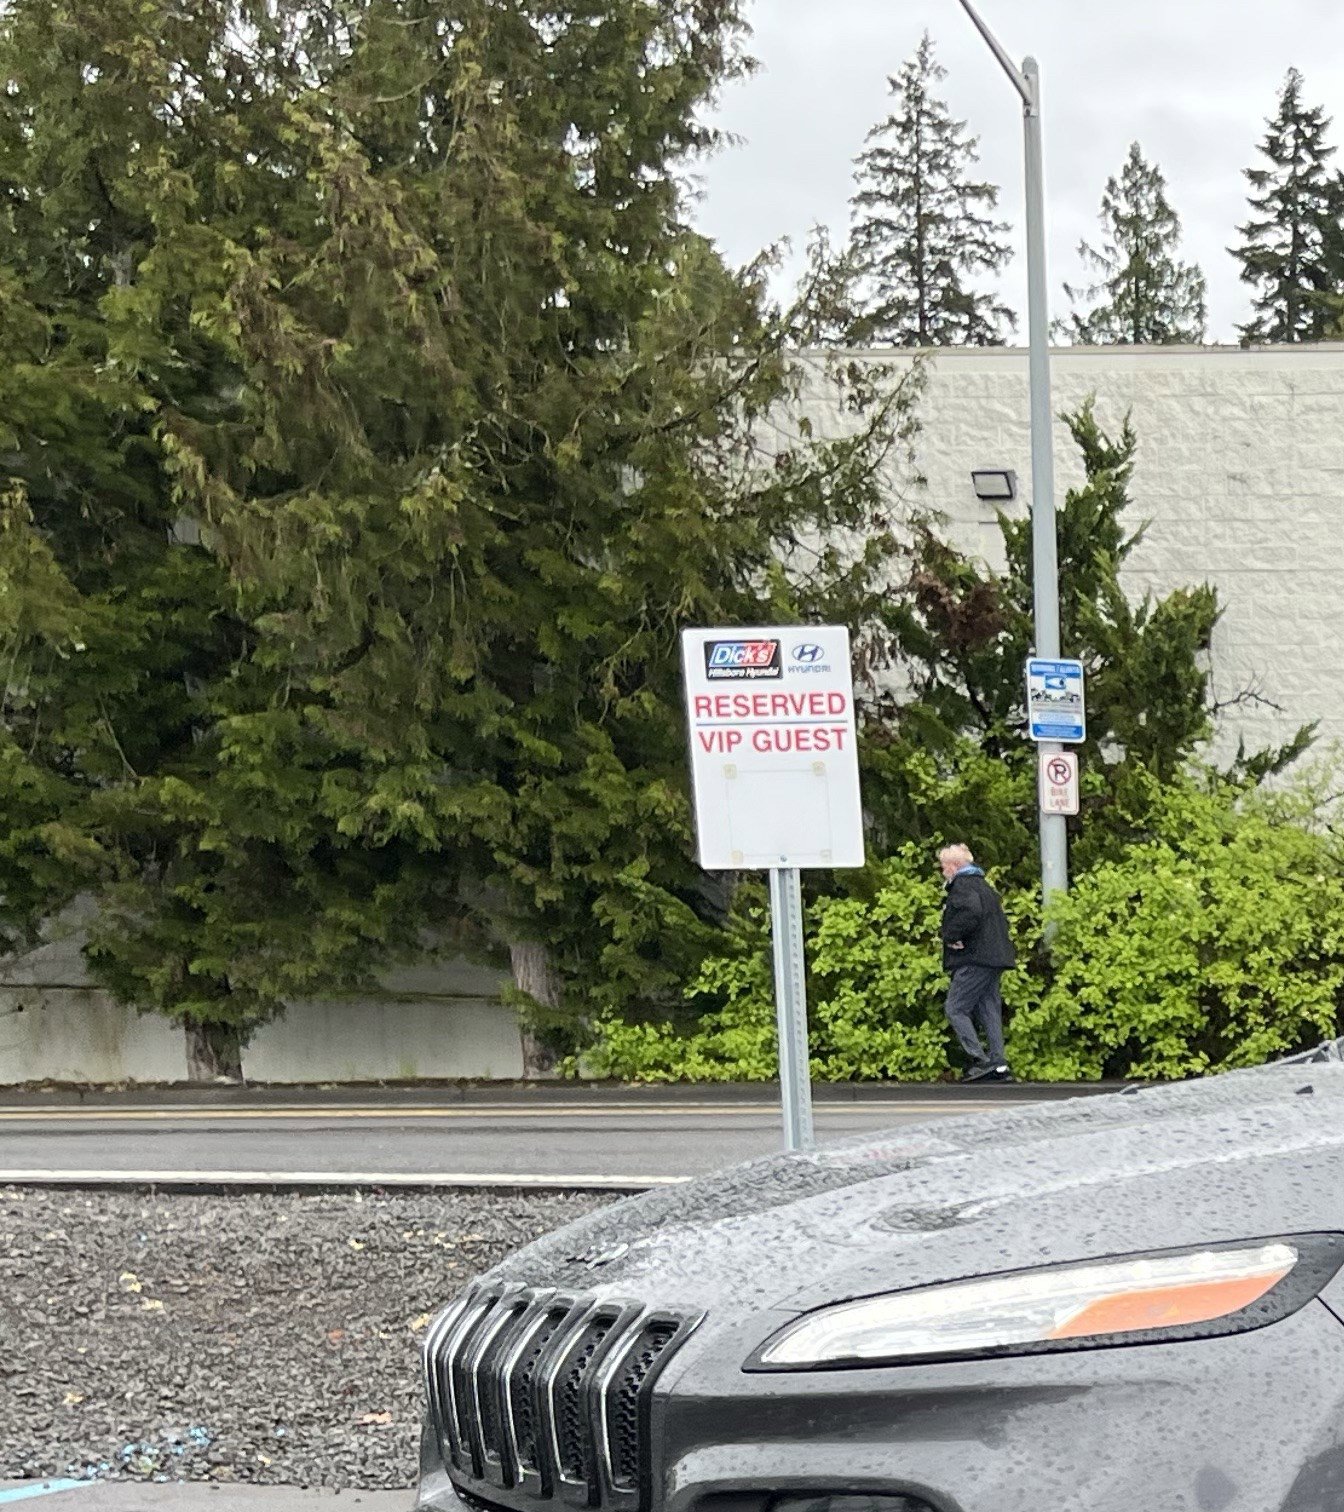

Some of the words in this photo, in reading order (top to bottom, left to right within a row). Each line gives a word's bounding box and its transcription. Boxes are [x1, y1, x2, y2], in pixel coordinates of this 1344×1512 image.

[788, 664, 831, 673] HYUNDAI
[695, 692, 846, 718] RESERVED
[698, 730, 742, 753] VIP
[752, 728, 848, 752] GUEST
